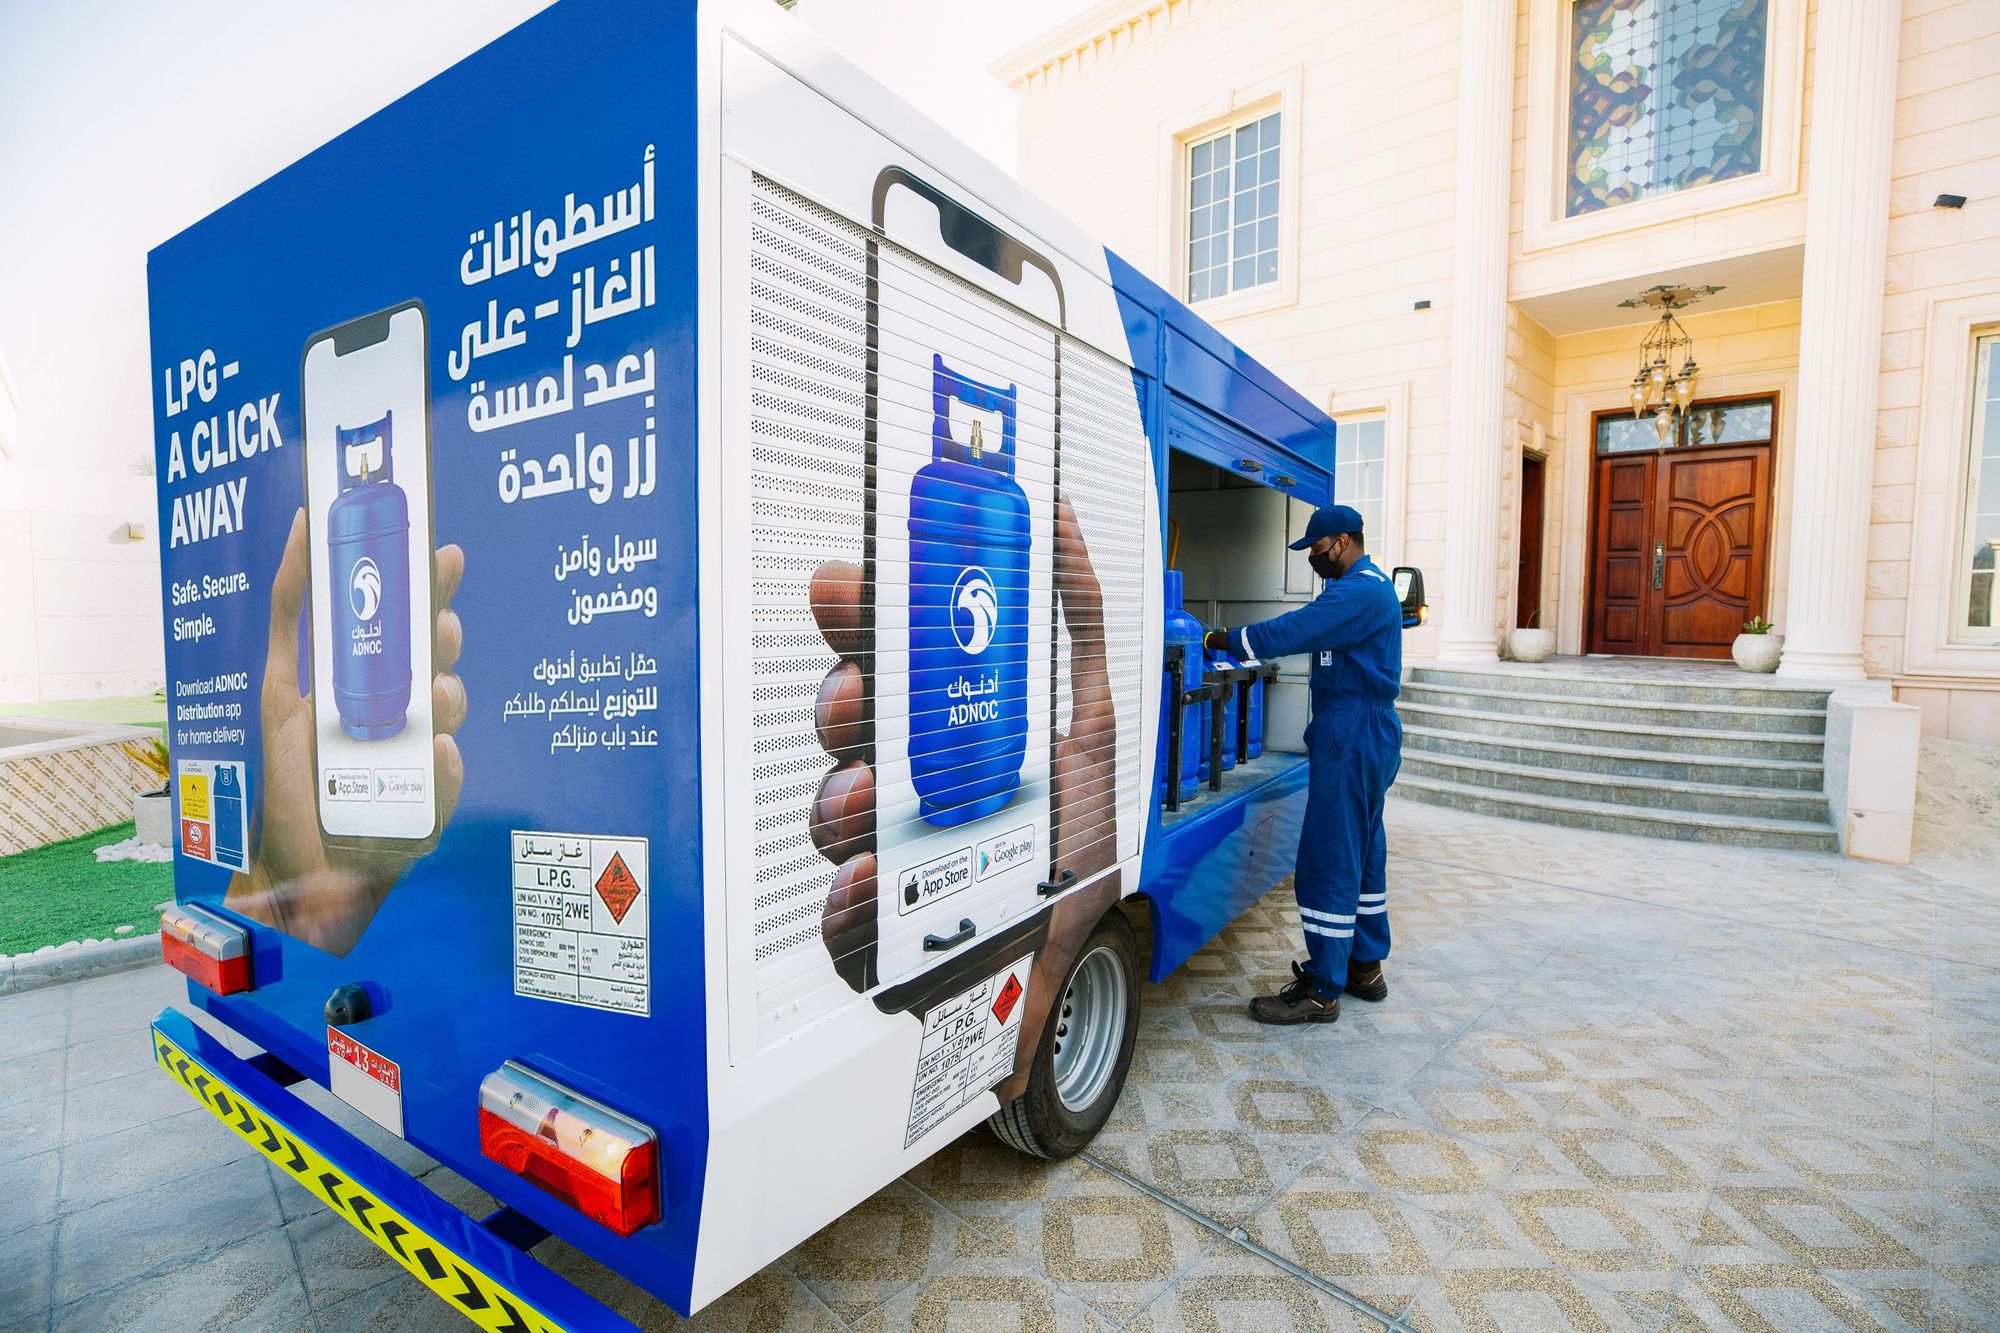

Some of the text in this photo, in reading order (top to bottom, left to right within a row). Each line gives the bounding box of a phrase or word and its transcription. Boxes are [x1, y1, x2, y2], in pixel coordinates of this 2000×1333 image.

[460, 143, 655, 285] أسطوانات
[566, 245, 655, 348] الغاز
[448, 299, 526, 381] على
[468, 348, 655, 433] بعد لمسة
[168, 392, 283, 483] A CLICK
[499, 417, 656, 504] زر واحدة
[170, 476, 248, 549] AWAY
[555, 534, 657, 581] سهل وآمن
[172, 572, 249, 606] Safe. Secure.
[567, 583, 657, 625] ومضمون
[174, 612, 216, 642] Simple.
[352, 620, 382, 640] أدنوك
[352, 640, 382, 656] ADNOC
[533, 650, 575, 685] أدنوك
[578, 654, 620, 683] تطبيق
[176, 673, 248, 697] Download ADNOC
[948, 669, 998, 701] أدنوك
[177, 703, 241, 721] Distribution app
[504, 686, 657, 722] للتوزيع ليصلكم طلبكم
[948, 700, 998, 726] ADNOC
[178, 726, 245, 746] for home delivery
[551, 723, 658, 755] عند باب منزلكم
[339, 781, 368, 796] App Store
[389, 780, 423, 795] Google play
[522, 840, 582, 862] غاز سائل
[994, 844, 1018, 862] Google
[1019, 840, 1032, 856] play
[537, 868, 575, 889] L.P.G.
[922, 855, 968, 879] Download on the
[923, 867, 968, 896] App Store
[517, 907, 526, 917] UN
[541, 911, 562, 926] 1075
[565, 902, 589, 920] 2WE
[965, 983, 988, 1010] غاز
[933, 1004, 962, 1029] سائل
[944, 1011, 976, 1042] L.P.G.
[963, 1027, 984, 1050] 2WE
[355, 1046, 369, 1073] 13
[918, 1072, 928, 1082] UN
[942, 1051, 960, 1071] 1075
[920, 1059, 929, 1070] UN
[916, 1072, 948, 1098] EMERGENCY
